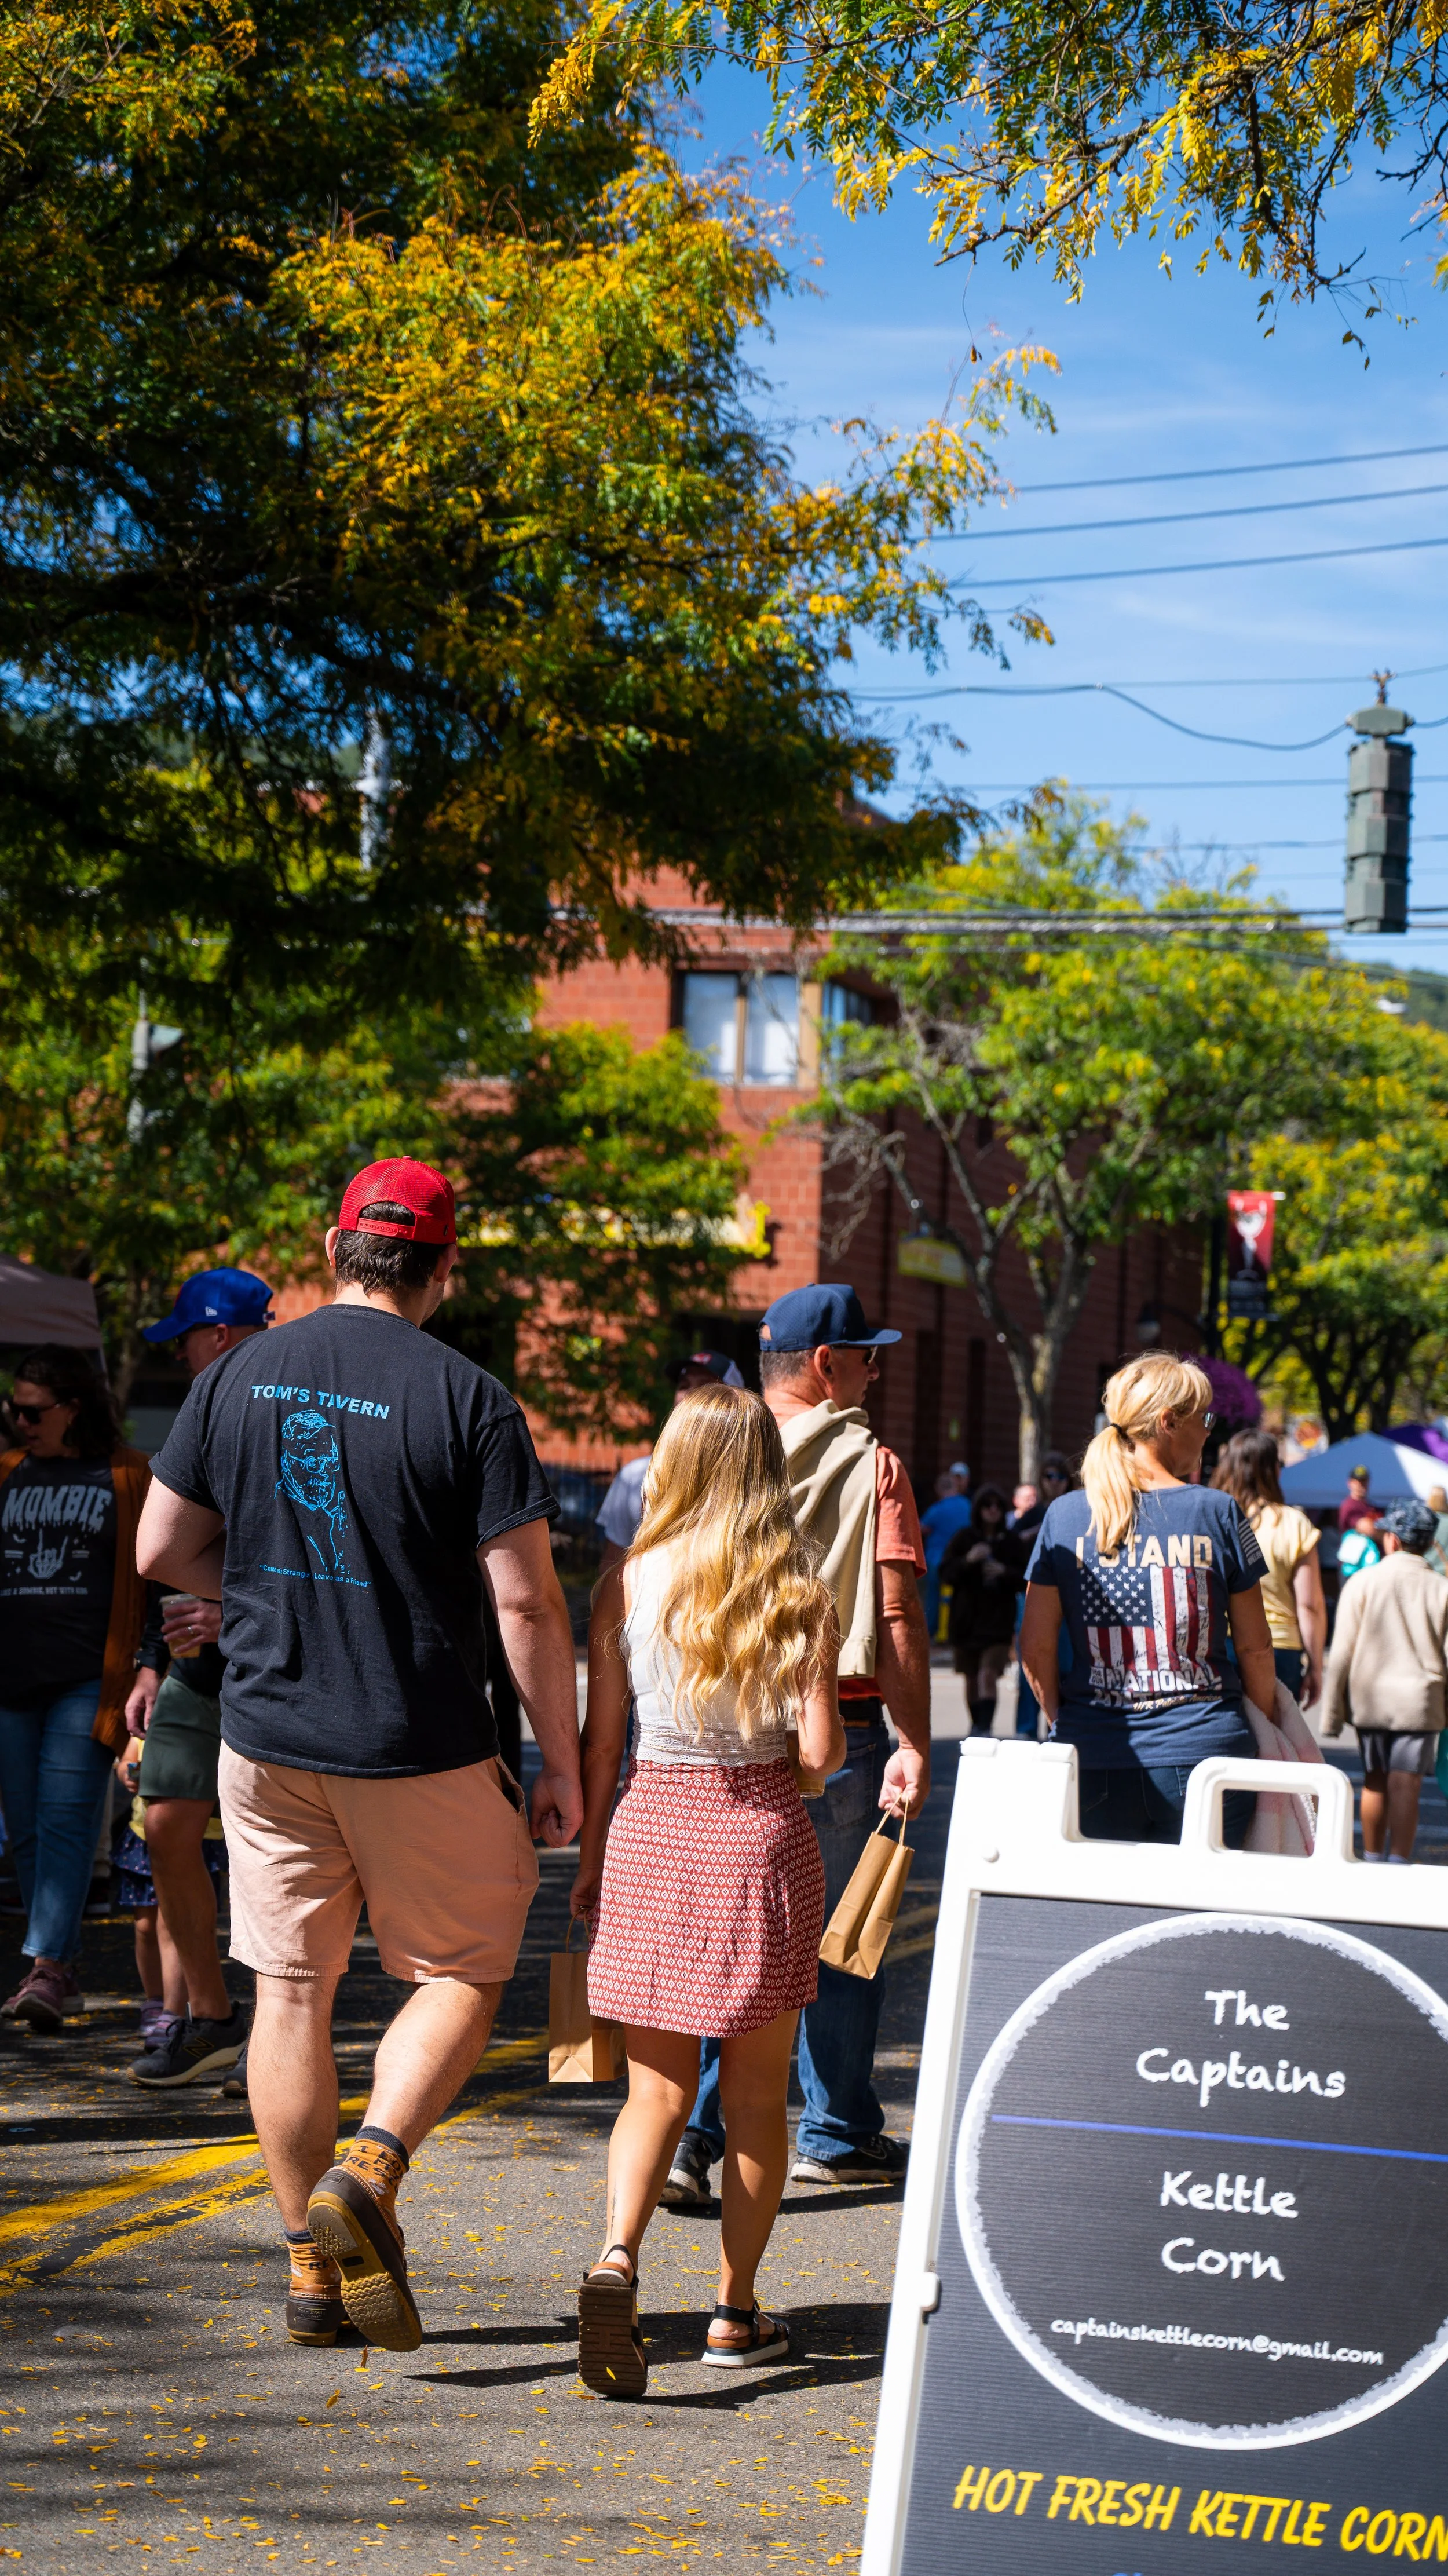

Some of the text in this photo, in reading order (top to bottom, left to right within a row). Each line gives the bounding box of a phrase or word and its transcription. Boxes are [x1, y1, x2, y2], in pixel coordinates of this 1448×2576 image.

[251, 1384, 390, 1419] TOM'S TAVERN
[2, 1485, 112, 1534] MOMBIE
[1076, 1536, 1084, 1569] I
[1205, 1989, 1290, 2031] The
[1136, 2048, 1346, 2108] Captains
[1160, 2171, 1299, 2219] Kettle
[1161, 2237, 1285, 2282] Corn
[1051, 2317, 1384, 2365] captainskettlecorn@gmail.com
[953, 2465, 1448, 2562] HOT FRESH KETTLE CORN
